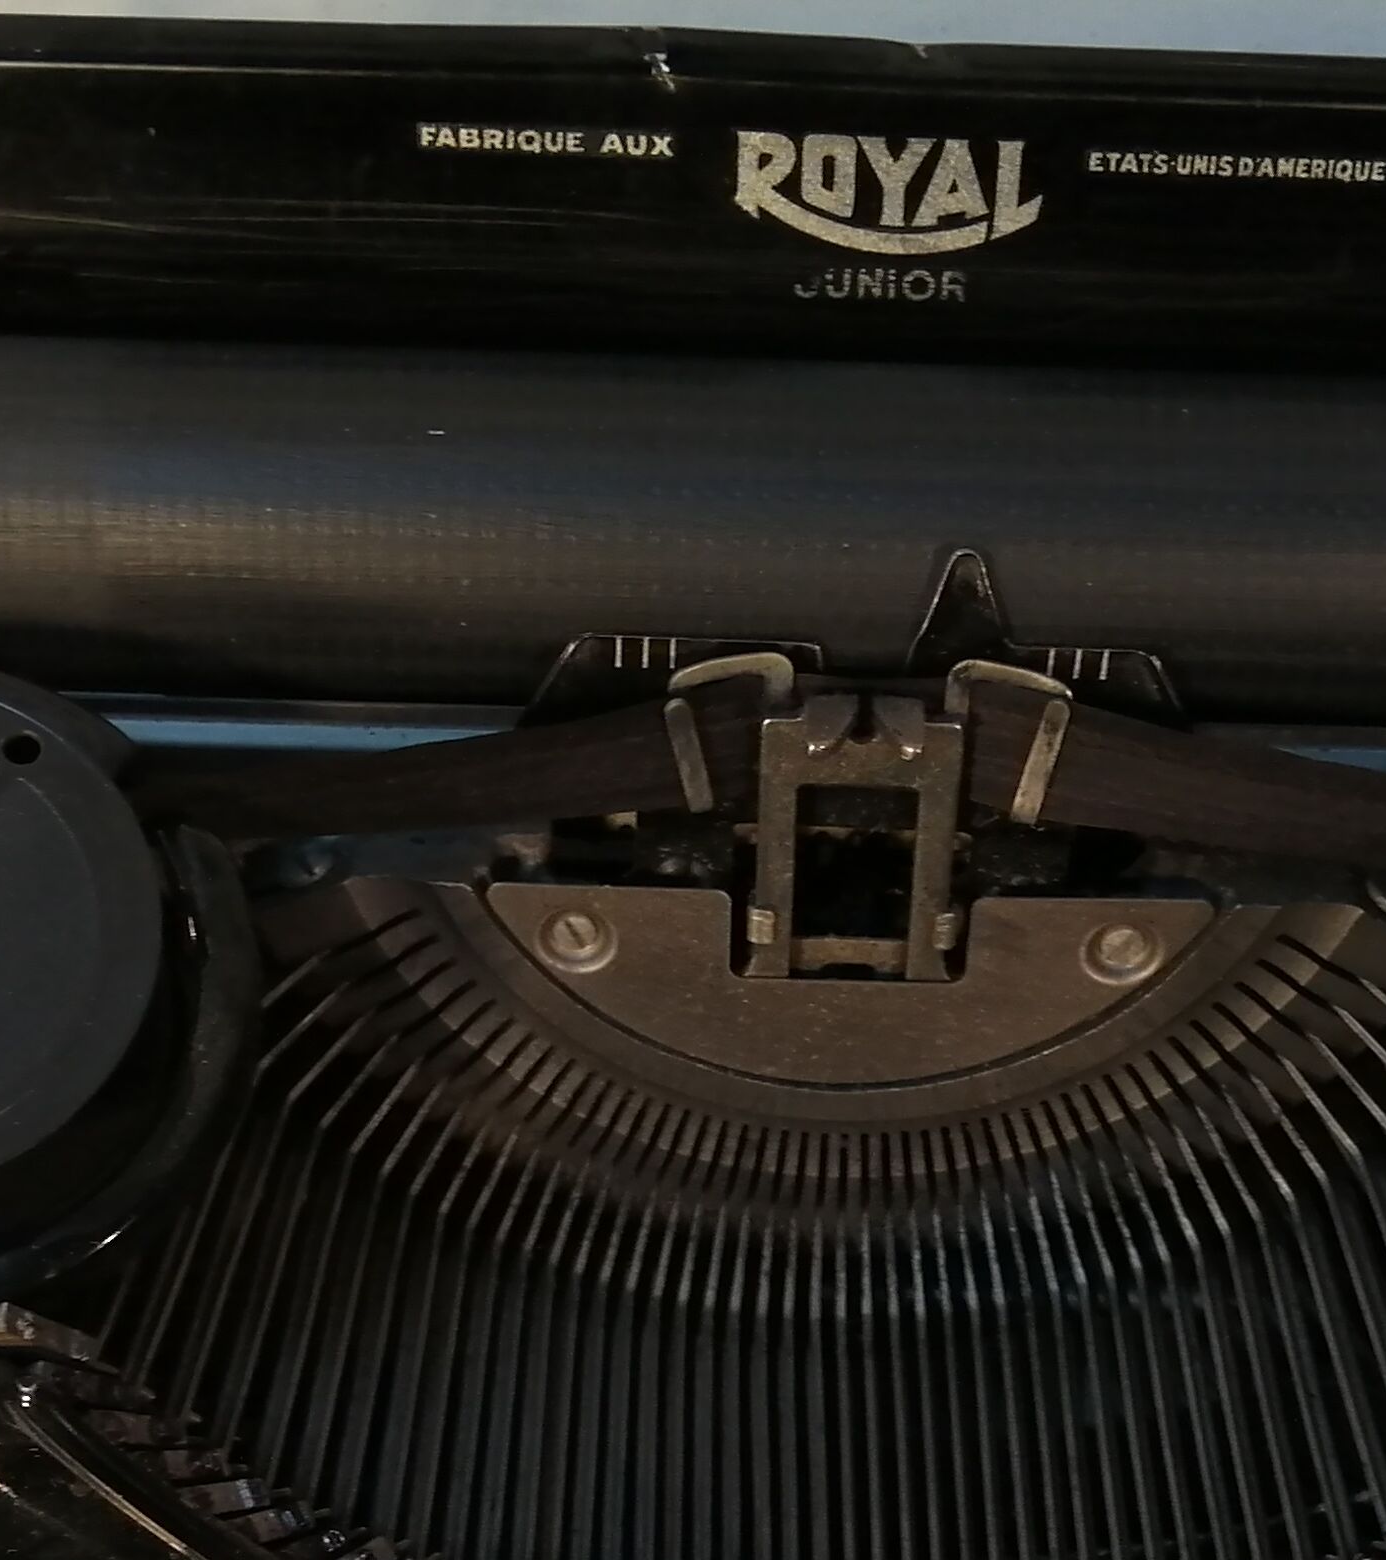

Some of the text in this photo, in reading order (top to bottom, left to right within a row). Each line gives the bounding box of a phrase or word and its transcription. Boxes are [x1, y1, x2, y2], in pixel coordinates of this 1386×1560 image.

[420, 127, 674, 157] FABRIQUE AUX
[734, 131, 1043, 254] ROYAL
